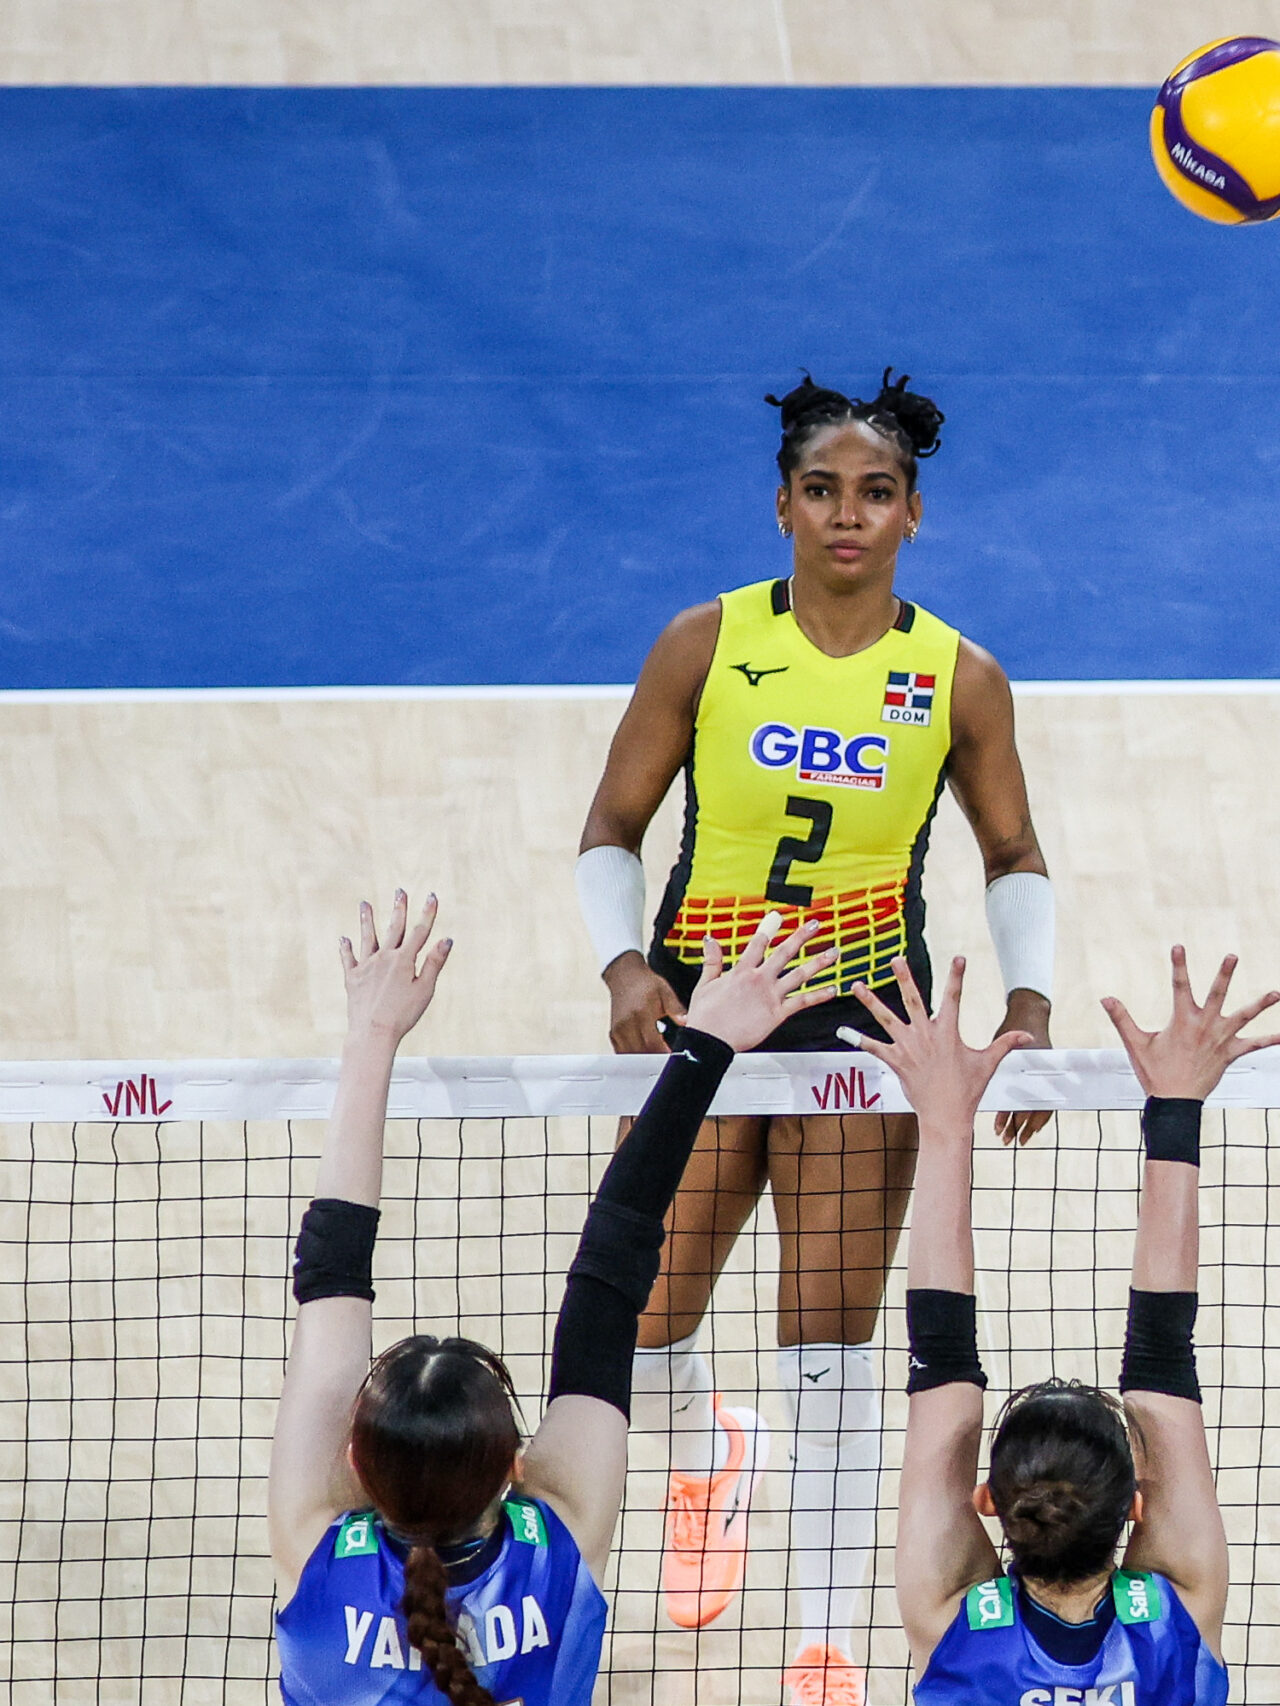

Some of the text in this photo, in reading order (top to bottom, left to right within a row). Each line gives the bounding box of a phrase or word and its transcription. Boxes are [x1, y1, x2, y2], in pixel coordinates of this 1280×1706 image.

[889, 709, 926, 723] DOM
[752, 724, 887, 774] GBC
[809, 771, 877, 788] FARMACIAS
[765, 795, 833, 907] 2
[102, 1073, 173, 1117] VNL
[811, 1066, 881, 1110] VNL
[1128, 1579, 1149, 1618] Salo
[344, 1595, 549, 1671] YAADA
